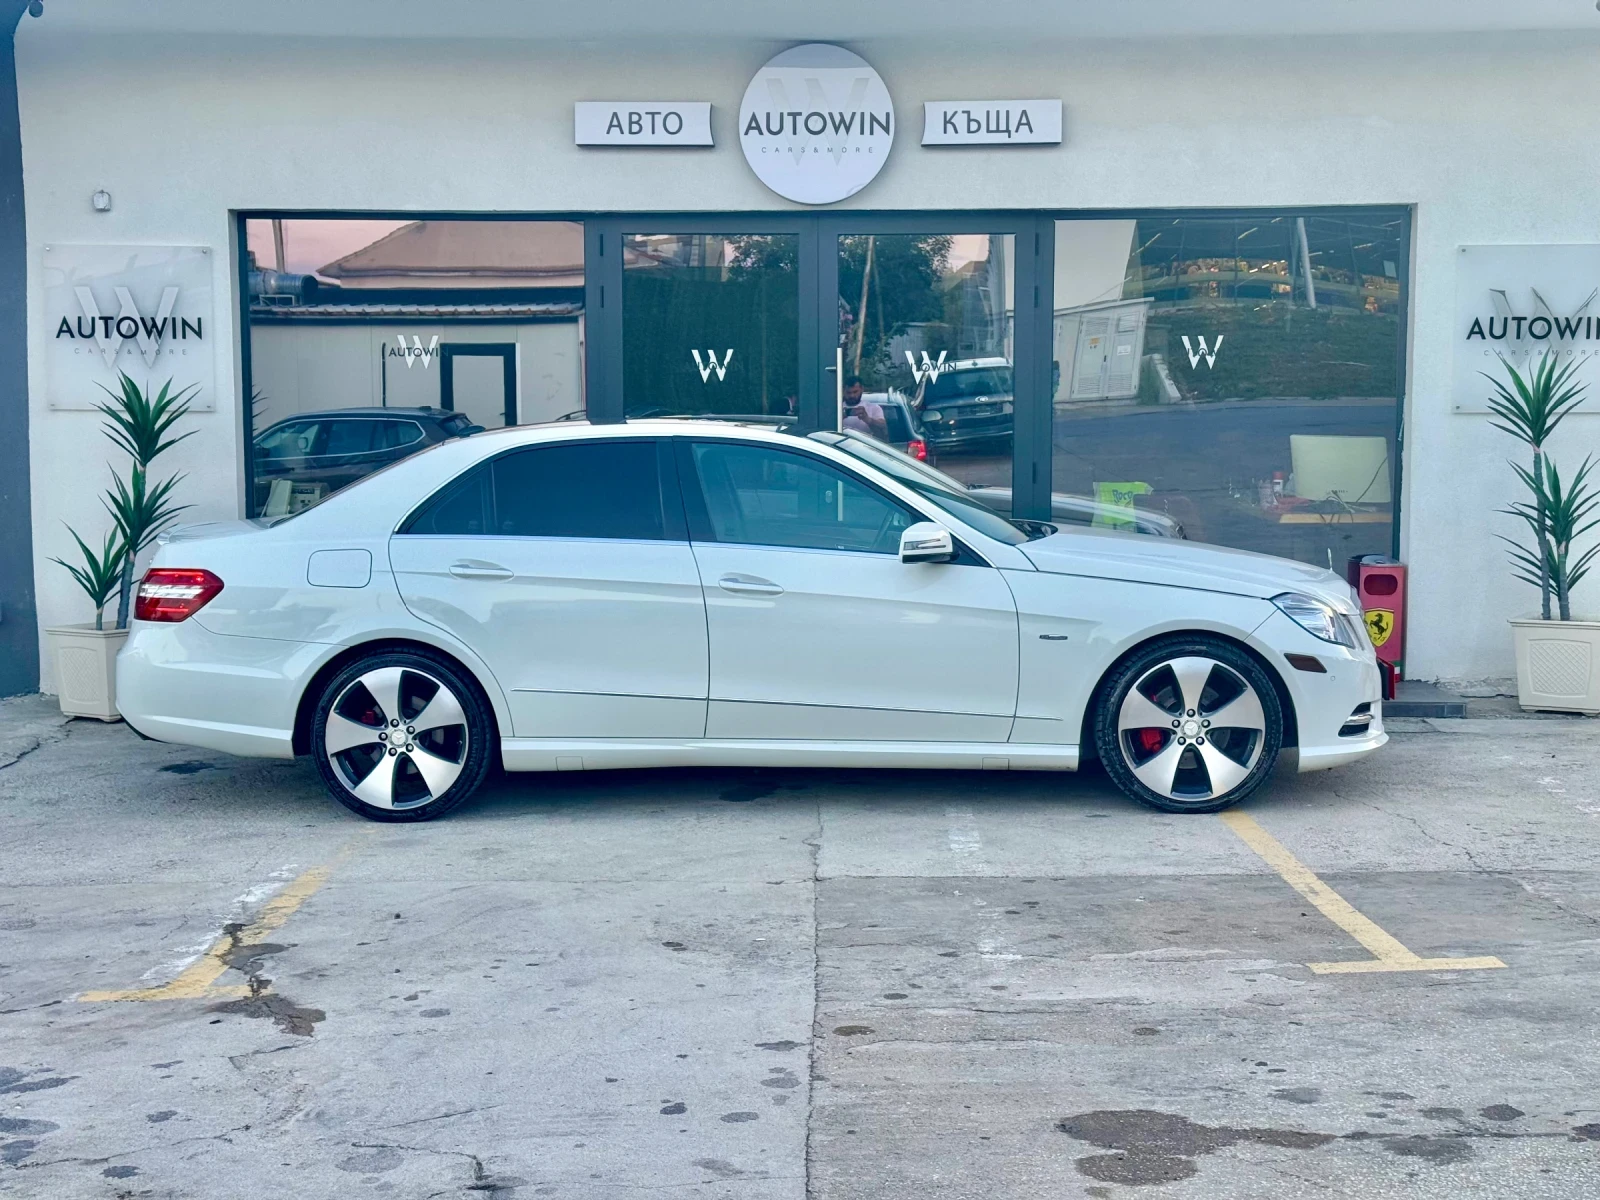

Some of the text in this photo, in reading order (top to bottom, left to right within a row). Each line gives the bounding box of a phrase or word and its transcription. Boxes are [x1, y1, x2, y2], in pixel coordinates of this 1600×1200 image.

[605, 111, 684, 136] АВТО
[743, 111, 891, 137] AUTOWIN
[942, 109, 1035, 139] КЪЩА
[55, 315, 203, 341] AUTOWIN
[1465, 316, 1600, 341] AUTOWI
